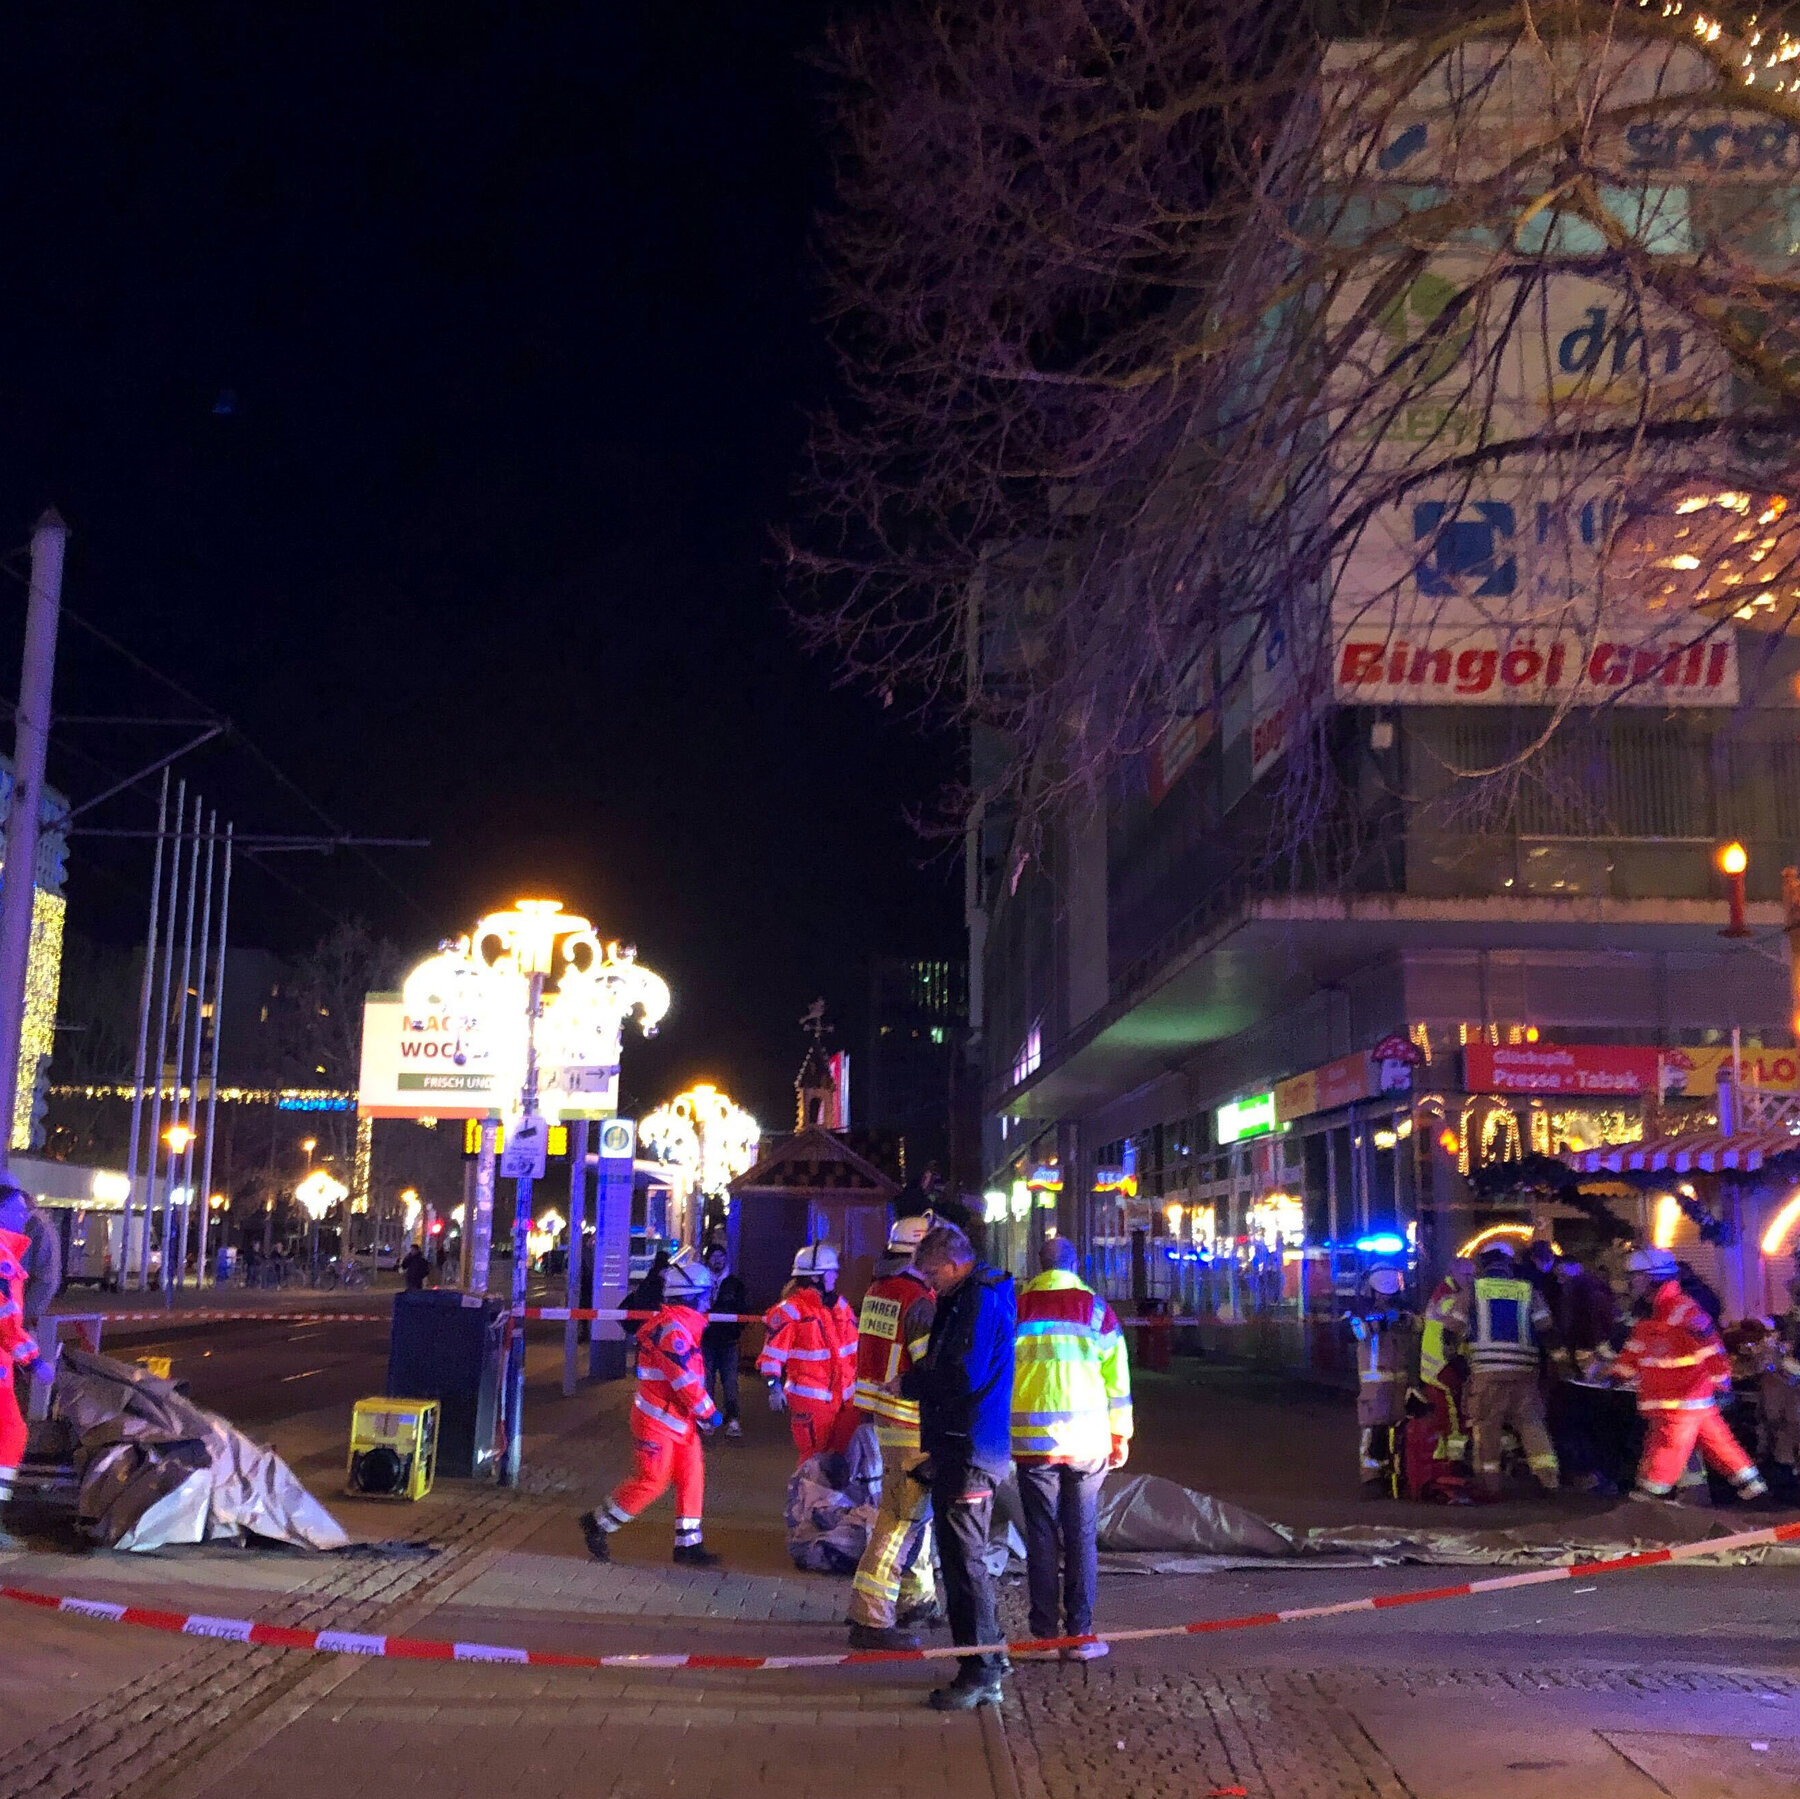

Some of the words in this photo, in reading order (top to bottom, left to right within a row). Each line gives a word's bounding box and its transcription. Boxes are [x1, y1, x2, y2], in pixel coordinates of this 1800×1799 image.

[1558, 305, 1683, 374] dm
[1339, 639, 1568, 695] Bingöl
[1589, 641, 1730, 688] Grill
[423, 1074, 464, 1089] FRISCH
[1493, 1068, 1561, 1088] Presse
[1577, 1070, 1640, 1089] Tabak
